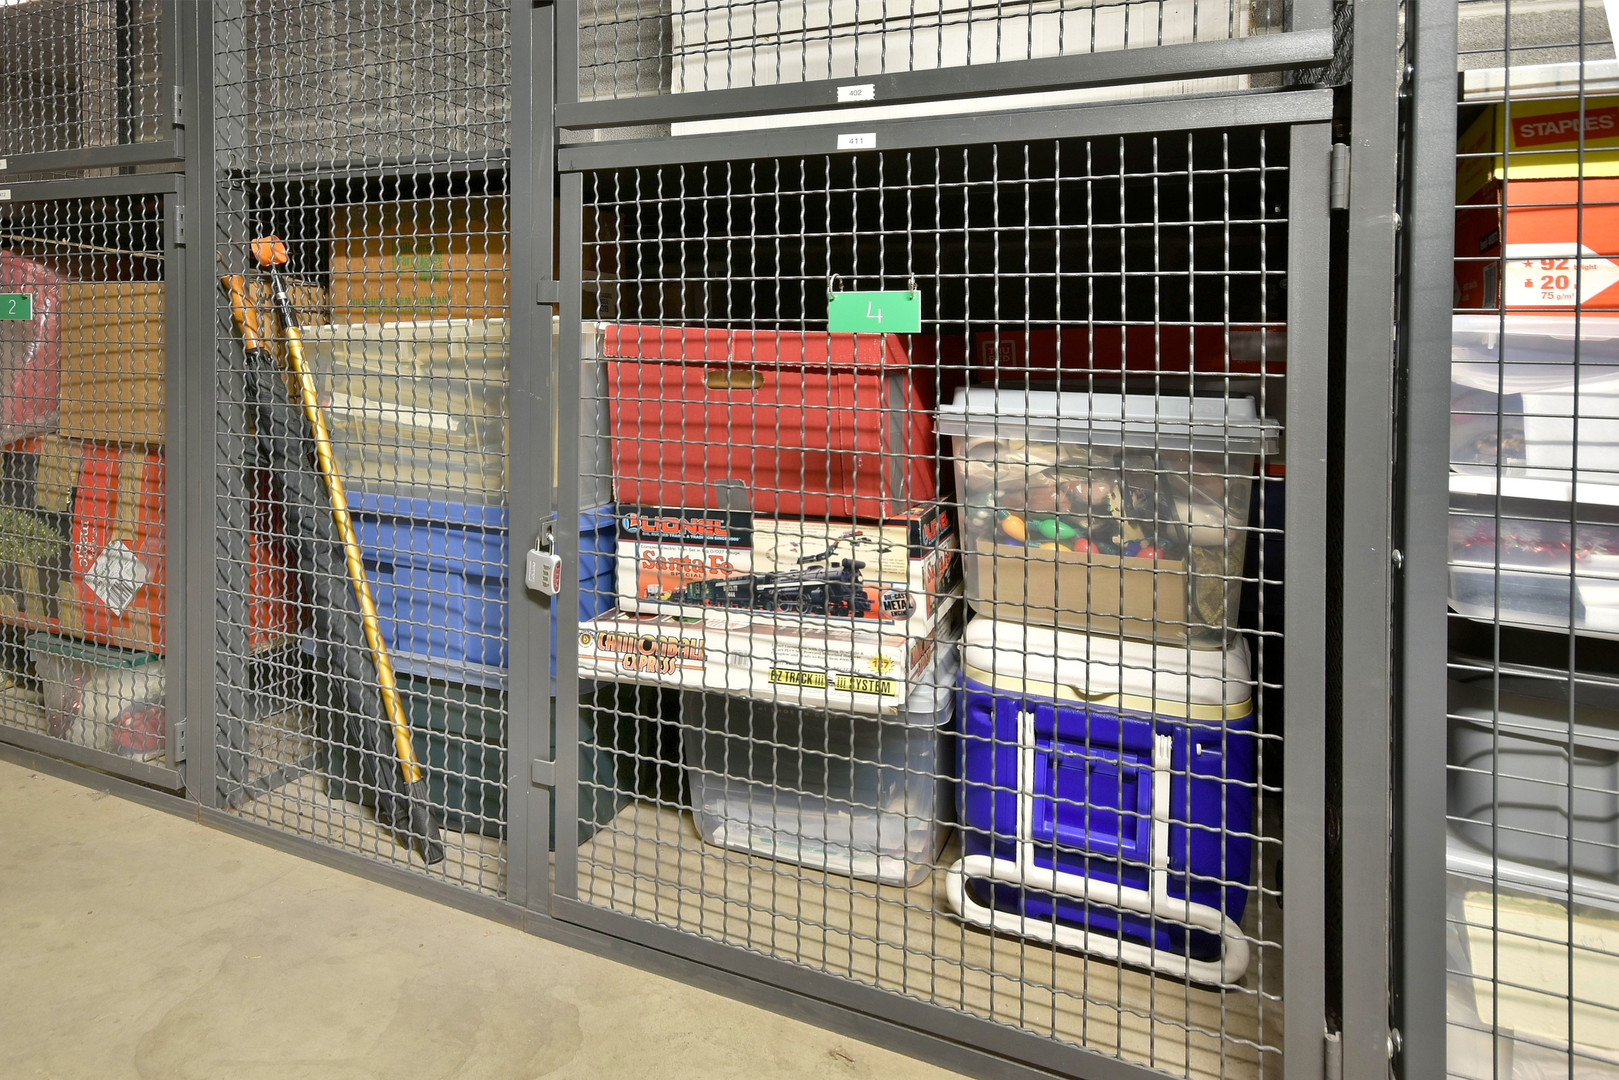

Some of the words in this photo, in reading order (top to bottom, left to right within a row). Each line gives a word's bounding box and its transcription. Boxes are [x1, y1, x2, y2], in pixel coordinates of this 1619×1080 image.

[848, 89, 863, 97] 402
[1519, 114, 1615, 138] STAPLES
[1540, 257, 1570, 271] 92
[1540, 274, 1570, 290] 20
[1541, 291, 1555, 300] 75
[8, 299, 17, 315] 2
[865, 301, 883, 324] 4
[642, 549, 704, 573] Santa
